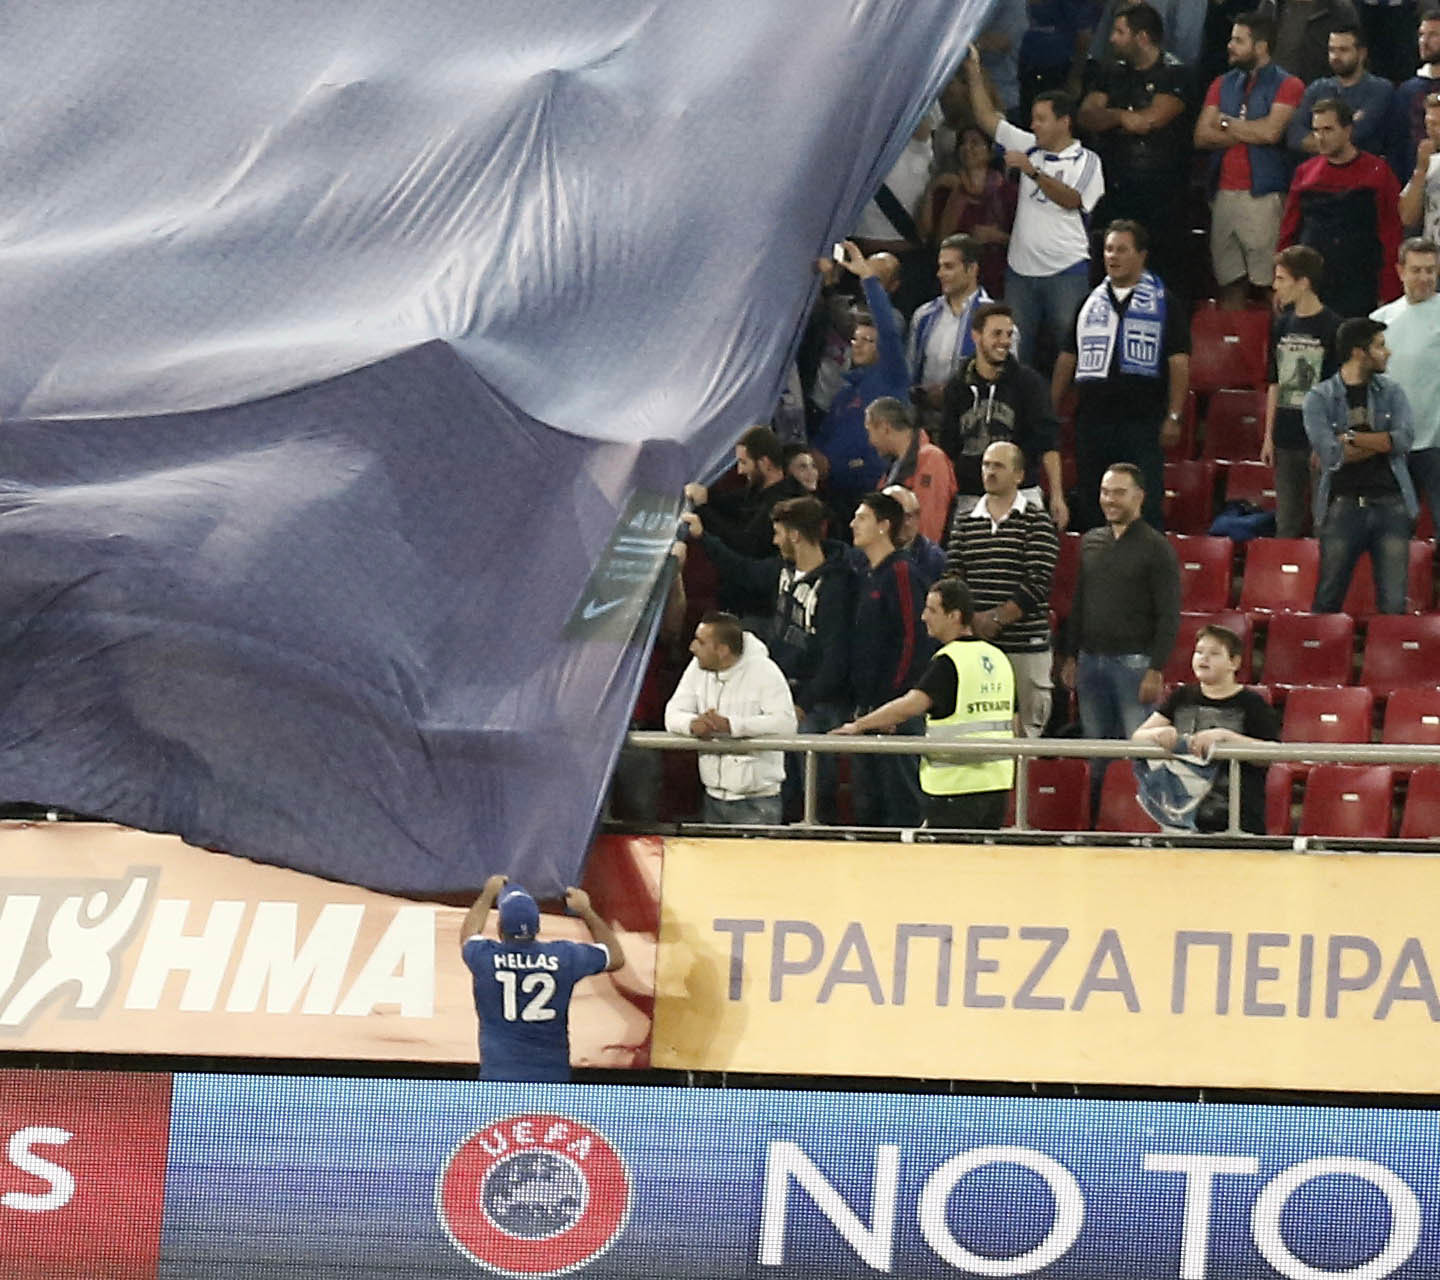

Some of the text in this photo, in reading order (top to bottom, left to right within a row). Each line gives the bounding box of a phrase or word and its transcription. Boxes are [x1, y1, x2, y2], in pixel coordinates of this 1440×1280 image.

[494, 952, 559, 972] HELLAS
[713, 918, 1140, 1013] ΤΡΑΠΕΖΑ
[494, 971, 558, 1022] 12
[479, 1121, 591, 1161] UEFA
[757, 1139, 1086, 1278] NO
[1144, 1148, 1424, 1280] TO
